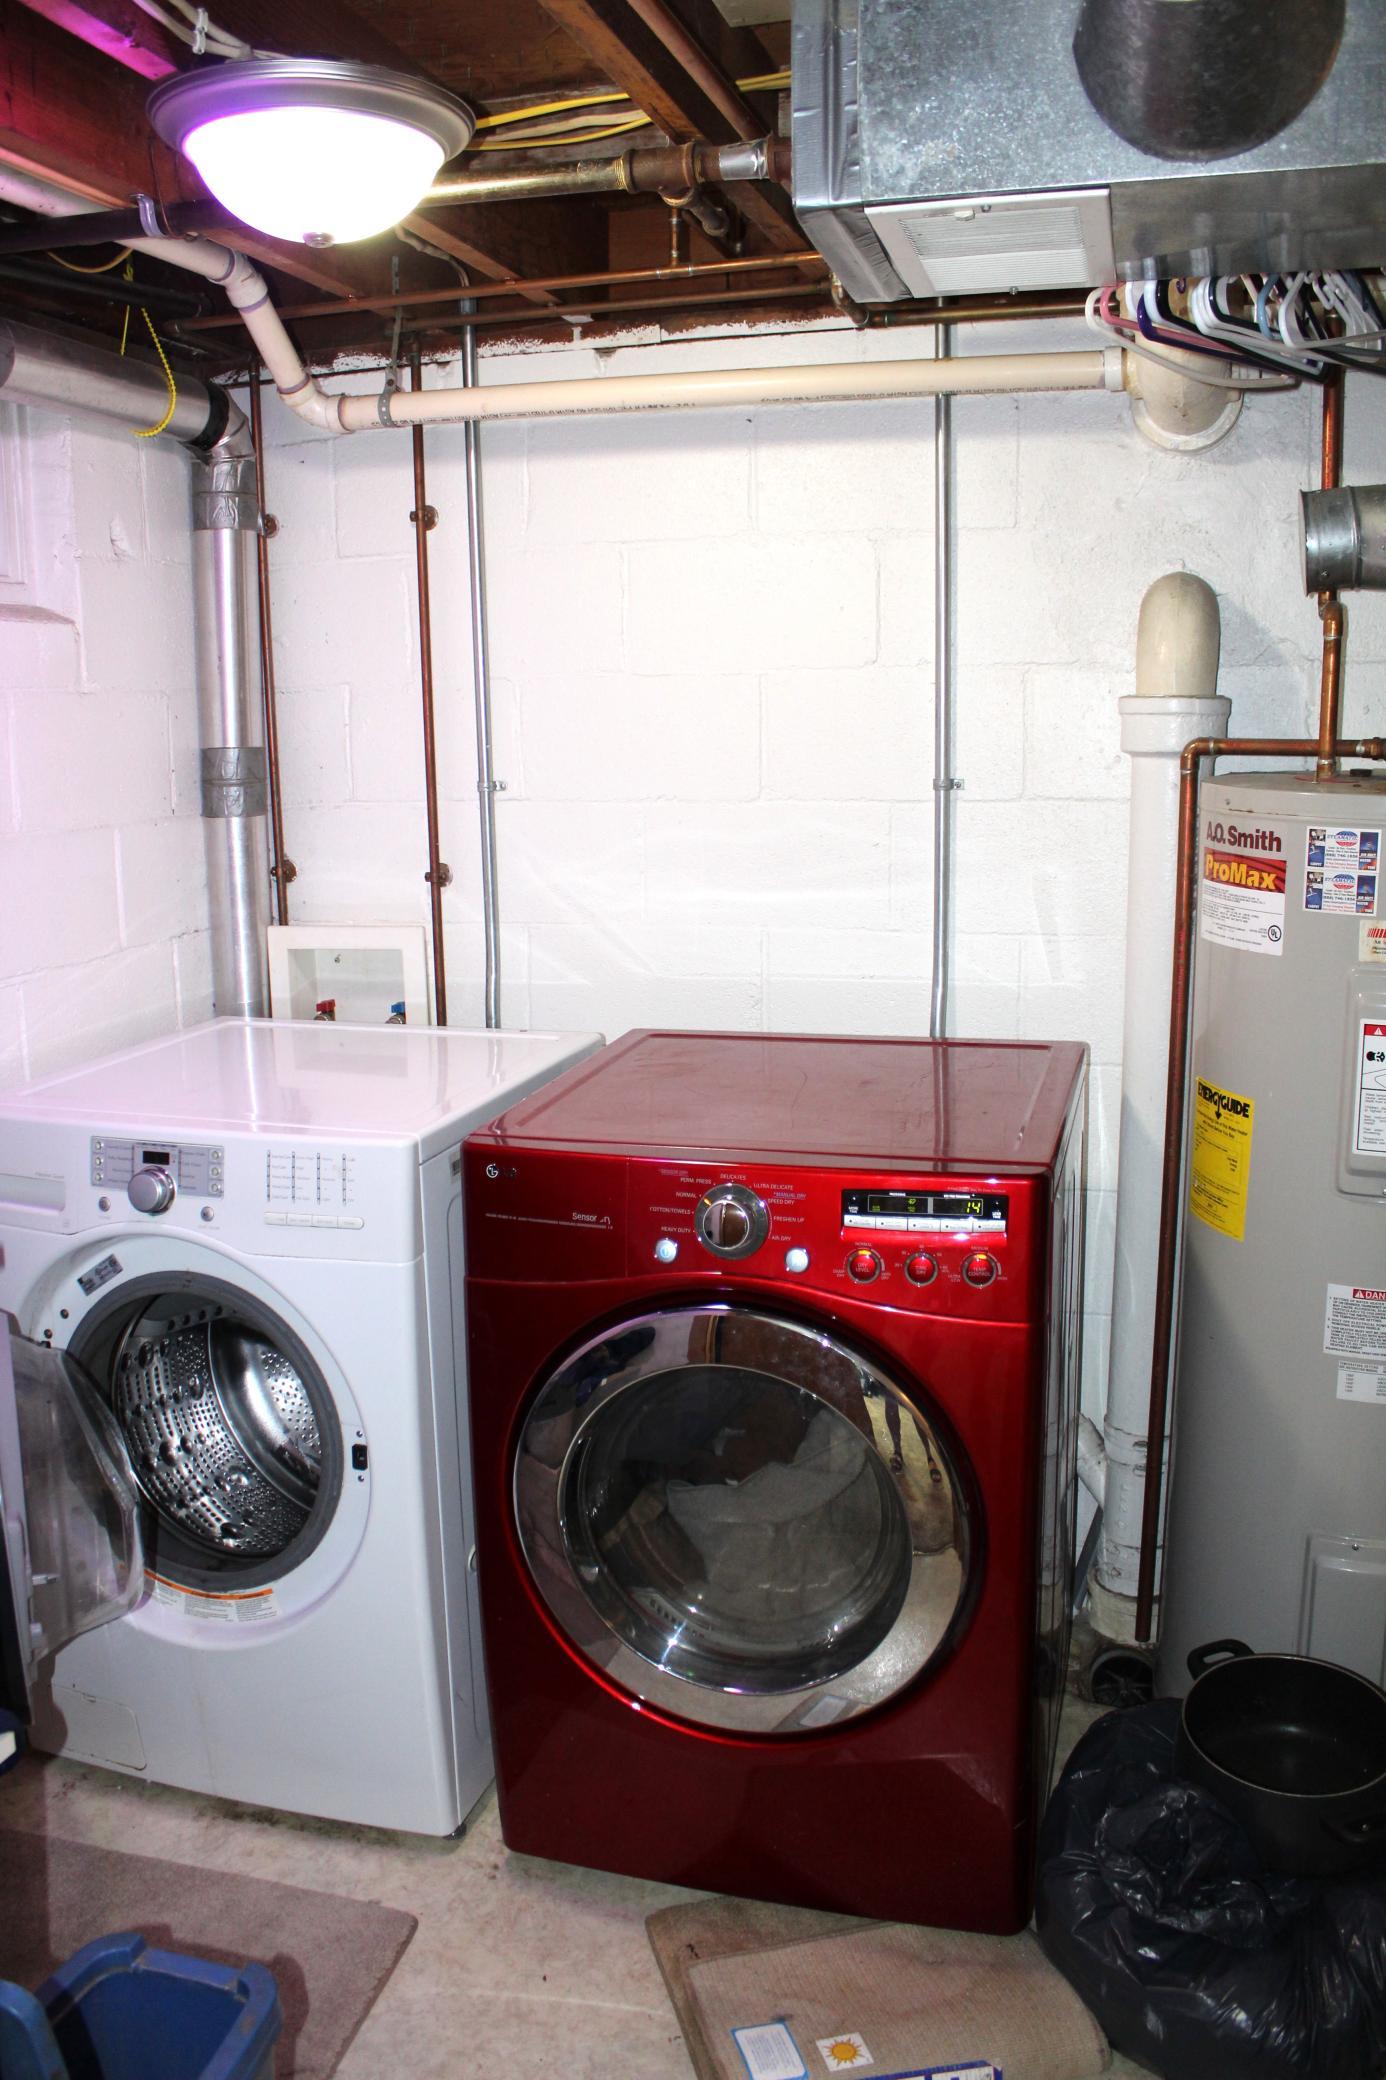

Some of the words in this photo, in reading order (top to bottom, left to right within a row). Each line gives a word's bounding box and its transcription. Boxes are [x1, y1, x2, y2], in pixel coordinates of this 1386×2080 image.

[1205, 853, 1277, 890] ProMax
[720, 1173, 746, 1181] DELICATES
[966, 1202, 981, 1214] 14
[572, 1212, 597, 1222] Sensor
[1365, 1291, 1386, 1300] DAN
